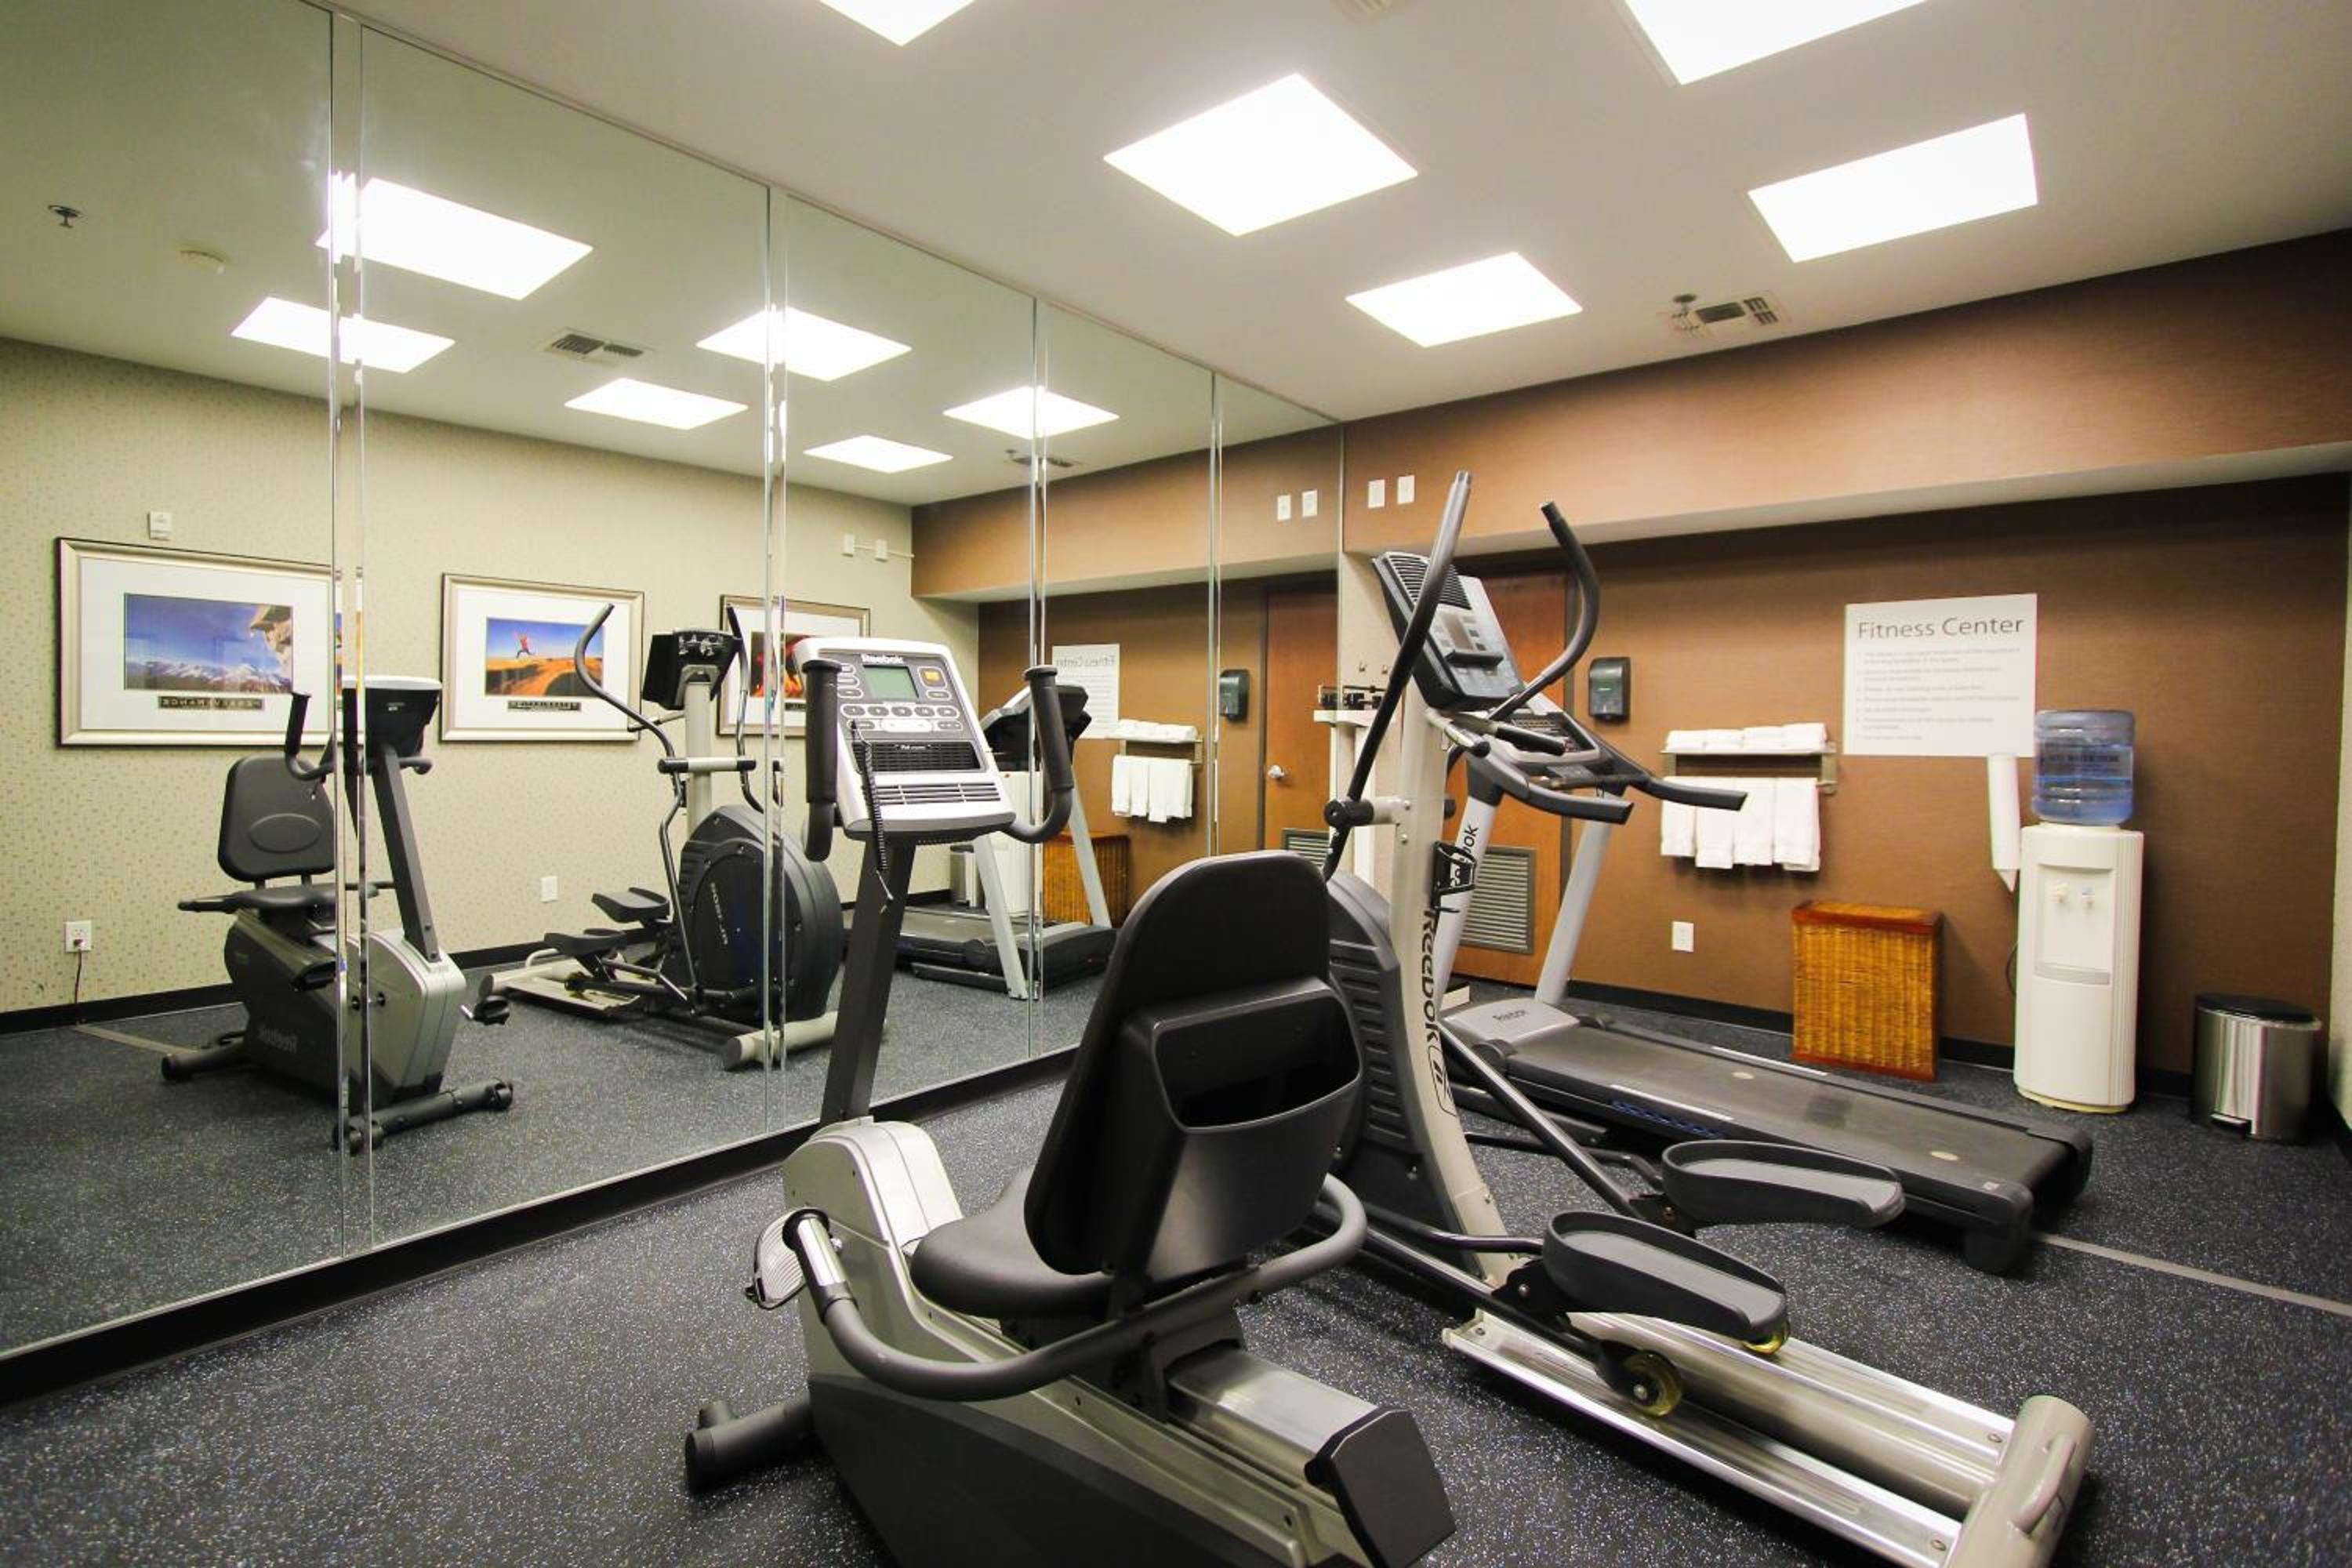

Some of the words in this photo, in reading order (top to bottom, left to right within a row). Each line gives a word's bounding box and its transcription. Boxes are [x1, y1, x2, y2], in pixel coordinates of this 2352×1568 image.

[1858, 621, 1935, 639] Fitness
[1941, 616, 2024, 637] Center
[1421, 909, 1443, 1043] Reebok
